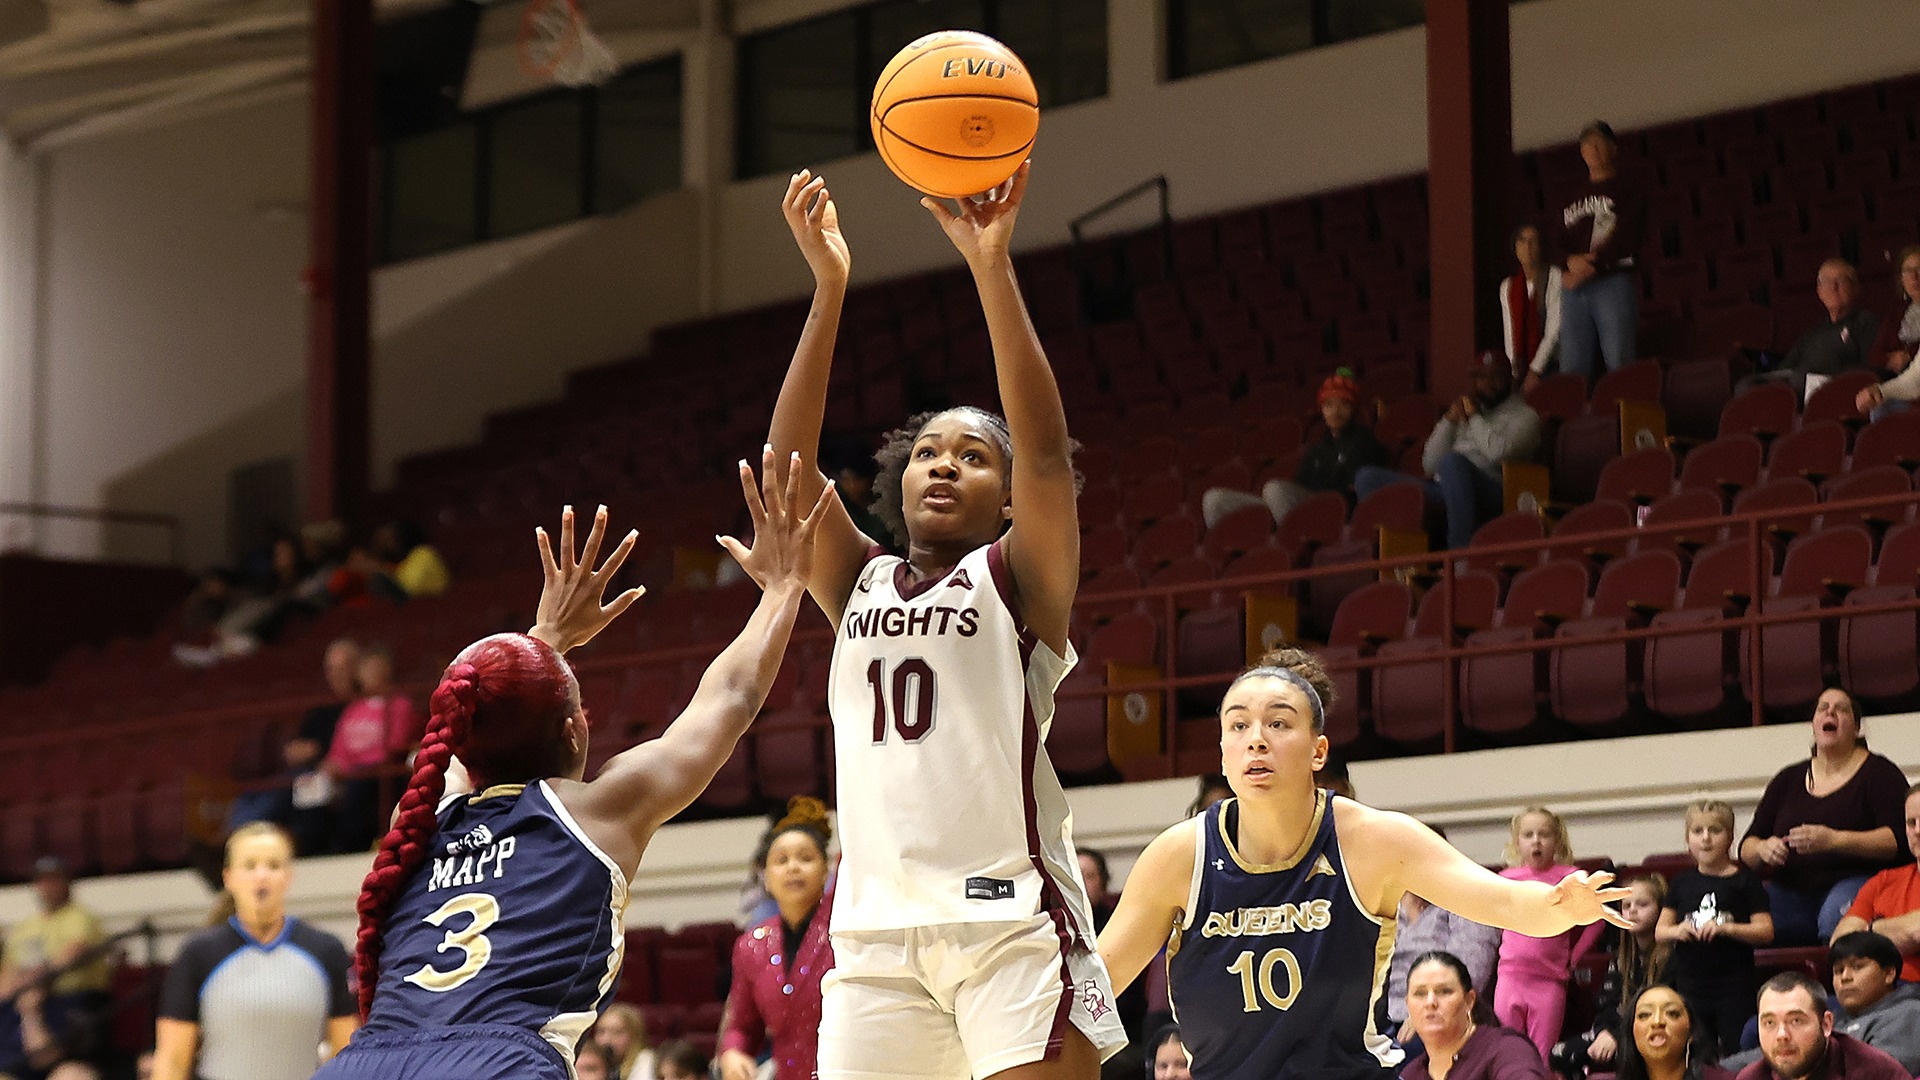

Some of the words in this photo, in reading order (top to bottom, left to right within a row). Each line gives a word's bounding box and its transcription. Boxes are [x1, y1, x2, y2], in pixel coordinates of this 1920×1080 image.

[942, 57, 1006, 79] EVO
[867, 656, 938, 746] 10
[428, 836, 516, 893] MAPP
[997, 884, 1008, 894] M
[403, 892, 500, 993] 3
[1201, 898, 1332, 939] QUEENS
[1226, 947, 1303, 1013] 10
